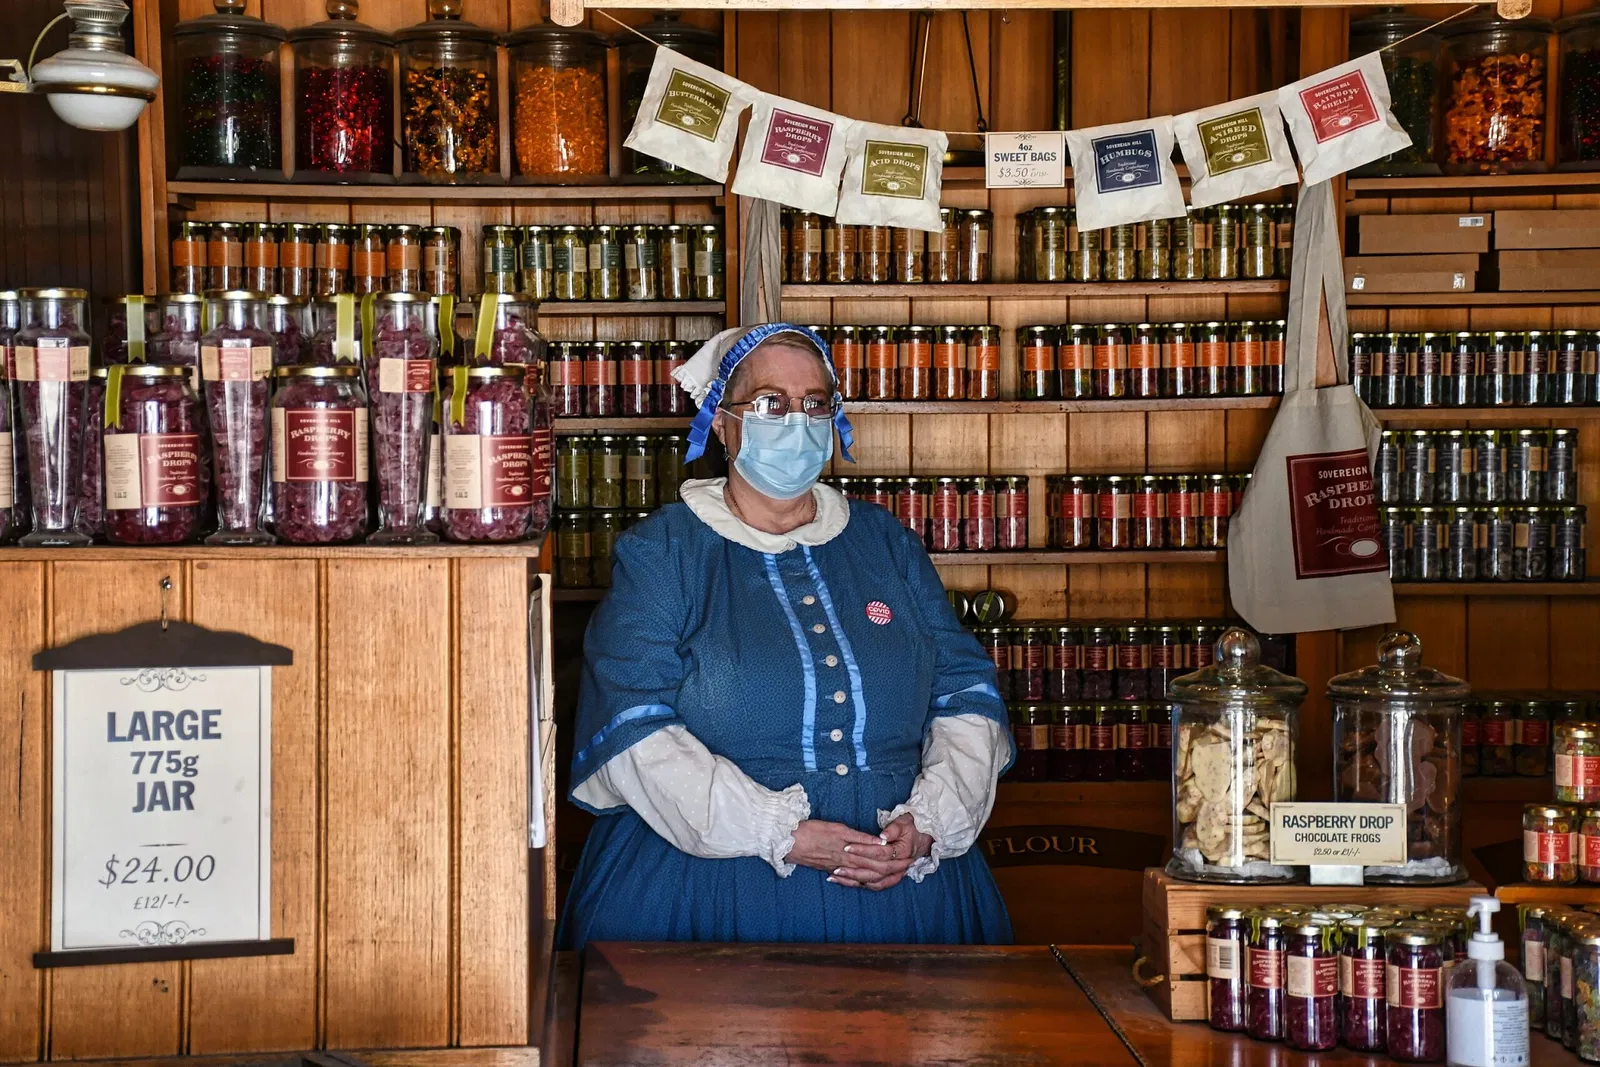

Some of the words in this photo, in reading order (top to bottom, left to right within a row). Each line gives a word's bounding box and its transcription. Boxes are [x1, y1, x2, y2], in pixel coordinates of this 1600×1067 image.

[668, 90, 722, 116] BUTTERBALLS
[1312, 88, 1360, 110] RAINBOW
[1322, 94, 1354, 110] SHELLS
[775, 126, 824, 143] RASPBERRY
[785, 132, 812, 143] DROPS
[1210, 124, 1257, 144] ANISEED
[1220, 132, 1248, 144] DROPS
[1018, 143, 1033, 151] 4oz
[1106, 142, 1131, 150] SOVEREIGN
[870, 158, 890, 168] ACID
[994, 152, 1027, 162] SWEET
[1031, 152, 1056, 162] BAGS
[1100, 149, 1152, 166] HUMBUGS
[893, 159, 921, 171] DROPS
[998, 166, 1028, 179] $3.50
[290, 426, 351, 440] RASPBERRY
[162, 459, 192, 467] DROPS
[1318, 465, 1368, 479] SOVEREIGN
[1340, 514, 1377, 525] Tradition
[1358, 523, 1379, 533] Conf
[868, 606, 890, 615] COVID
[107, 709, 222, 742] LARGE
[130, 750, 199, 778] 775g
[132, 780, 195, 813] JAR
[1282, 815, 1356, 828] RASPBERRY
[1360, 816, 1394, 829] DROP
[1294, 832, 1348, 842] CHOCOLATE
[1351, 833, 1381, 843] FROGS
[986, 836, 1099, 856] FLOUR
[98, 854, 216, 889] $24.00
[133, 894, 190, 910] £12/-/-
